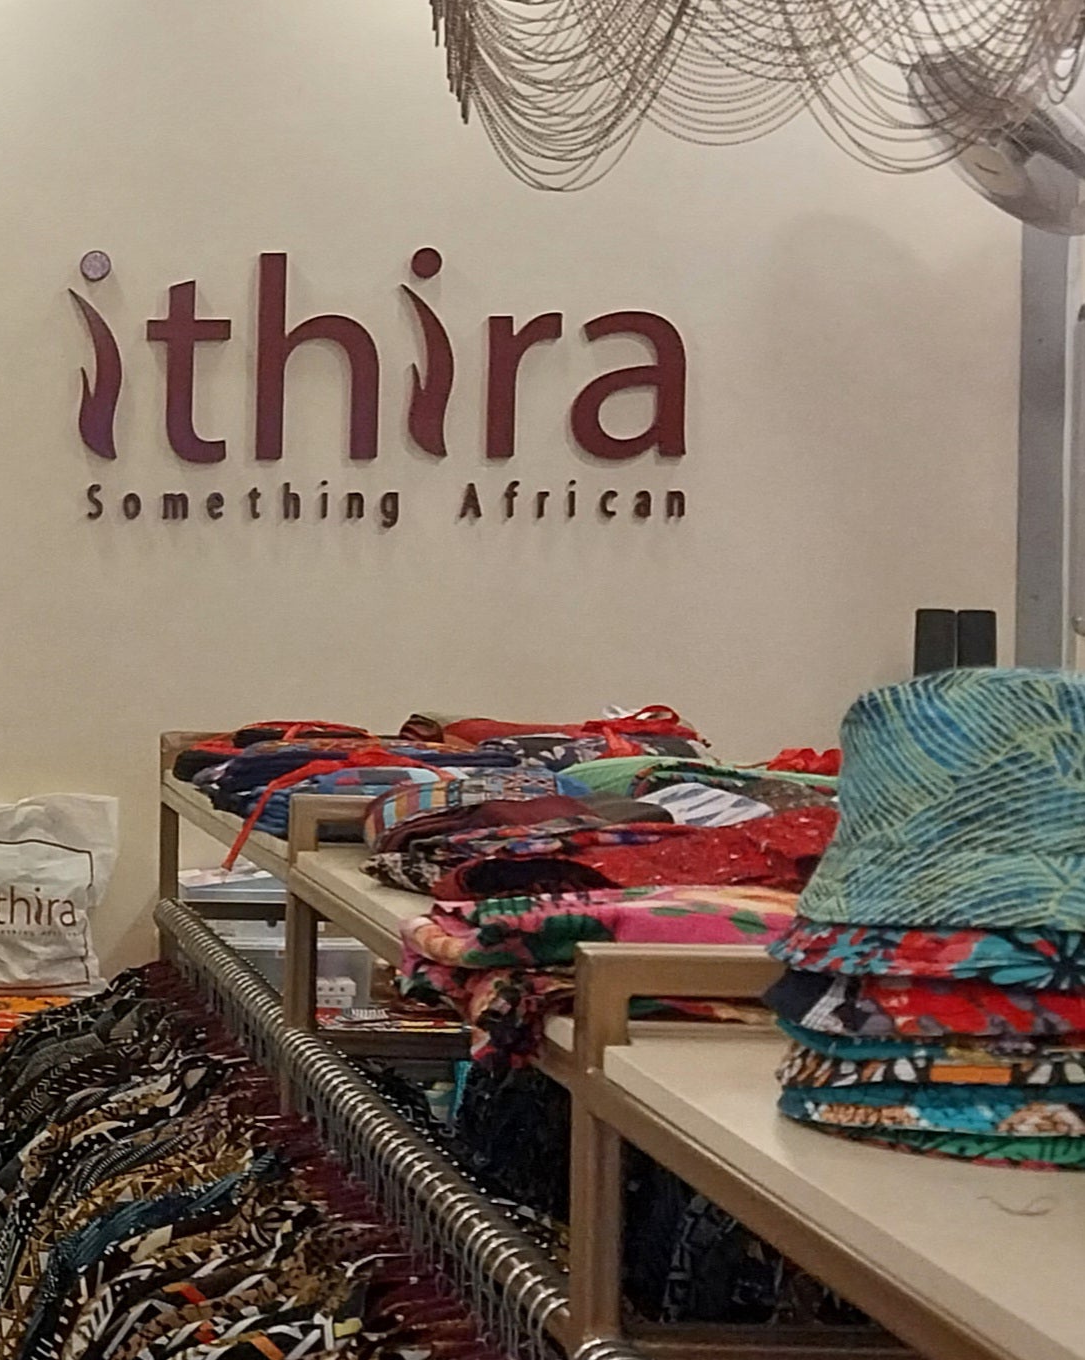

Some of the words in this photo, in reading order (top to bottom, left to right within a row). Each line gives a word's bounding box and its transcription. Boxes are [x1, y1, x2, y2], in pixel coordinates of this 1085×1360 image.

[68, 246, 686, 464] ithira
[85, 480, 401, 528] Something
[458, 479, 686, 520] African
